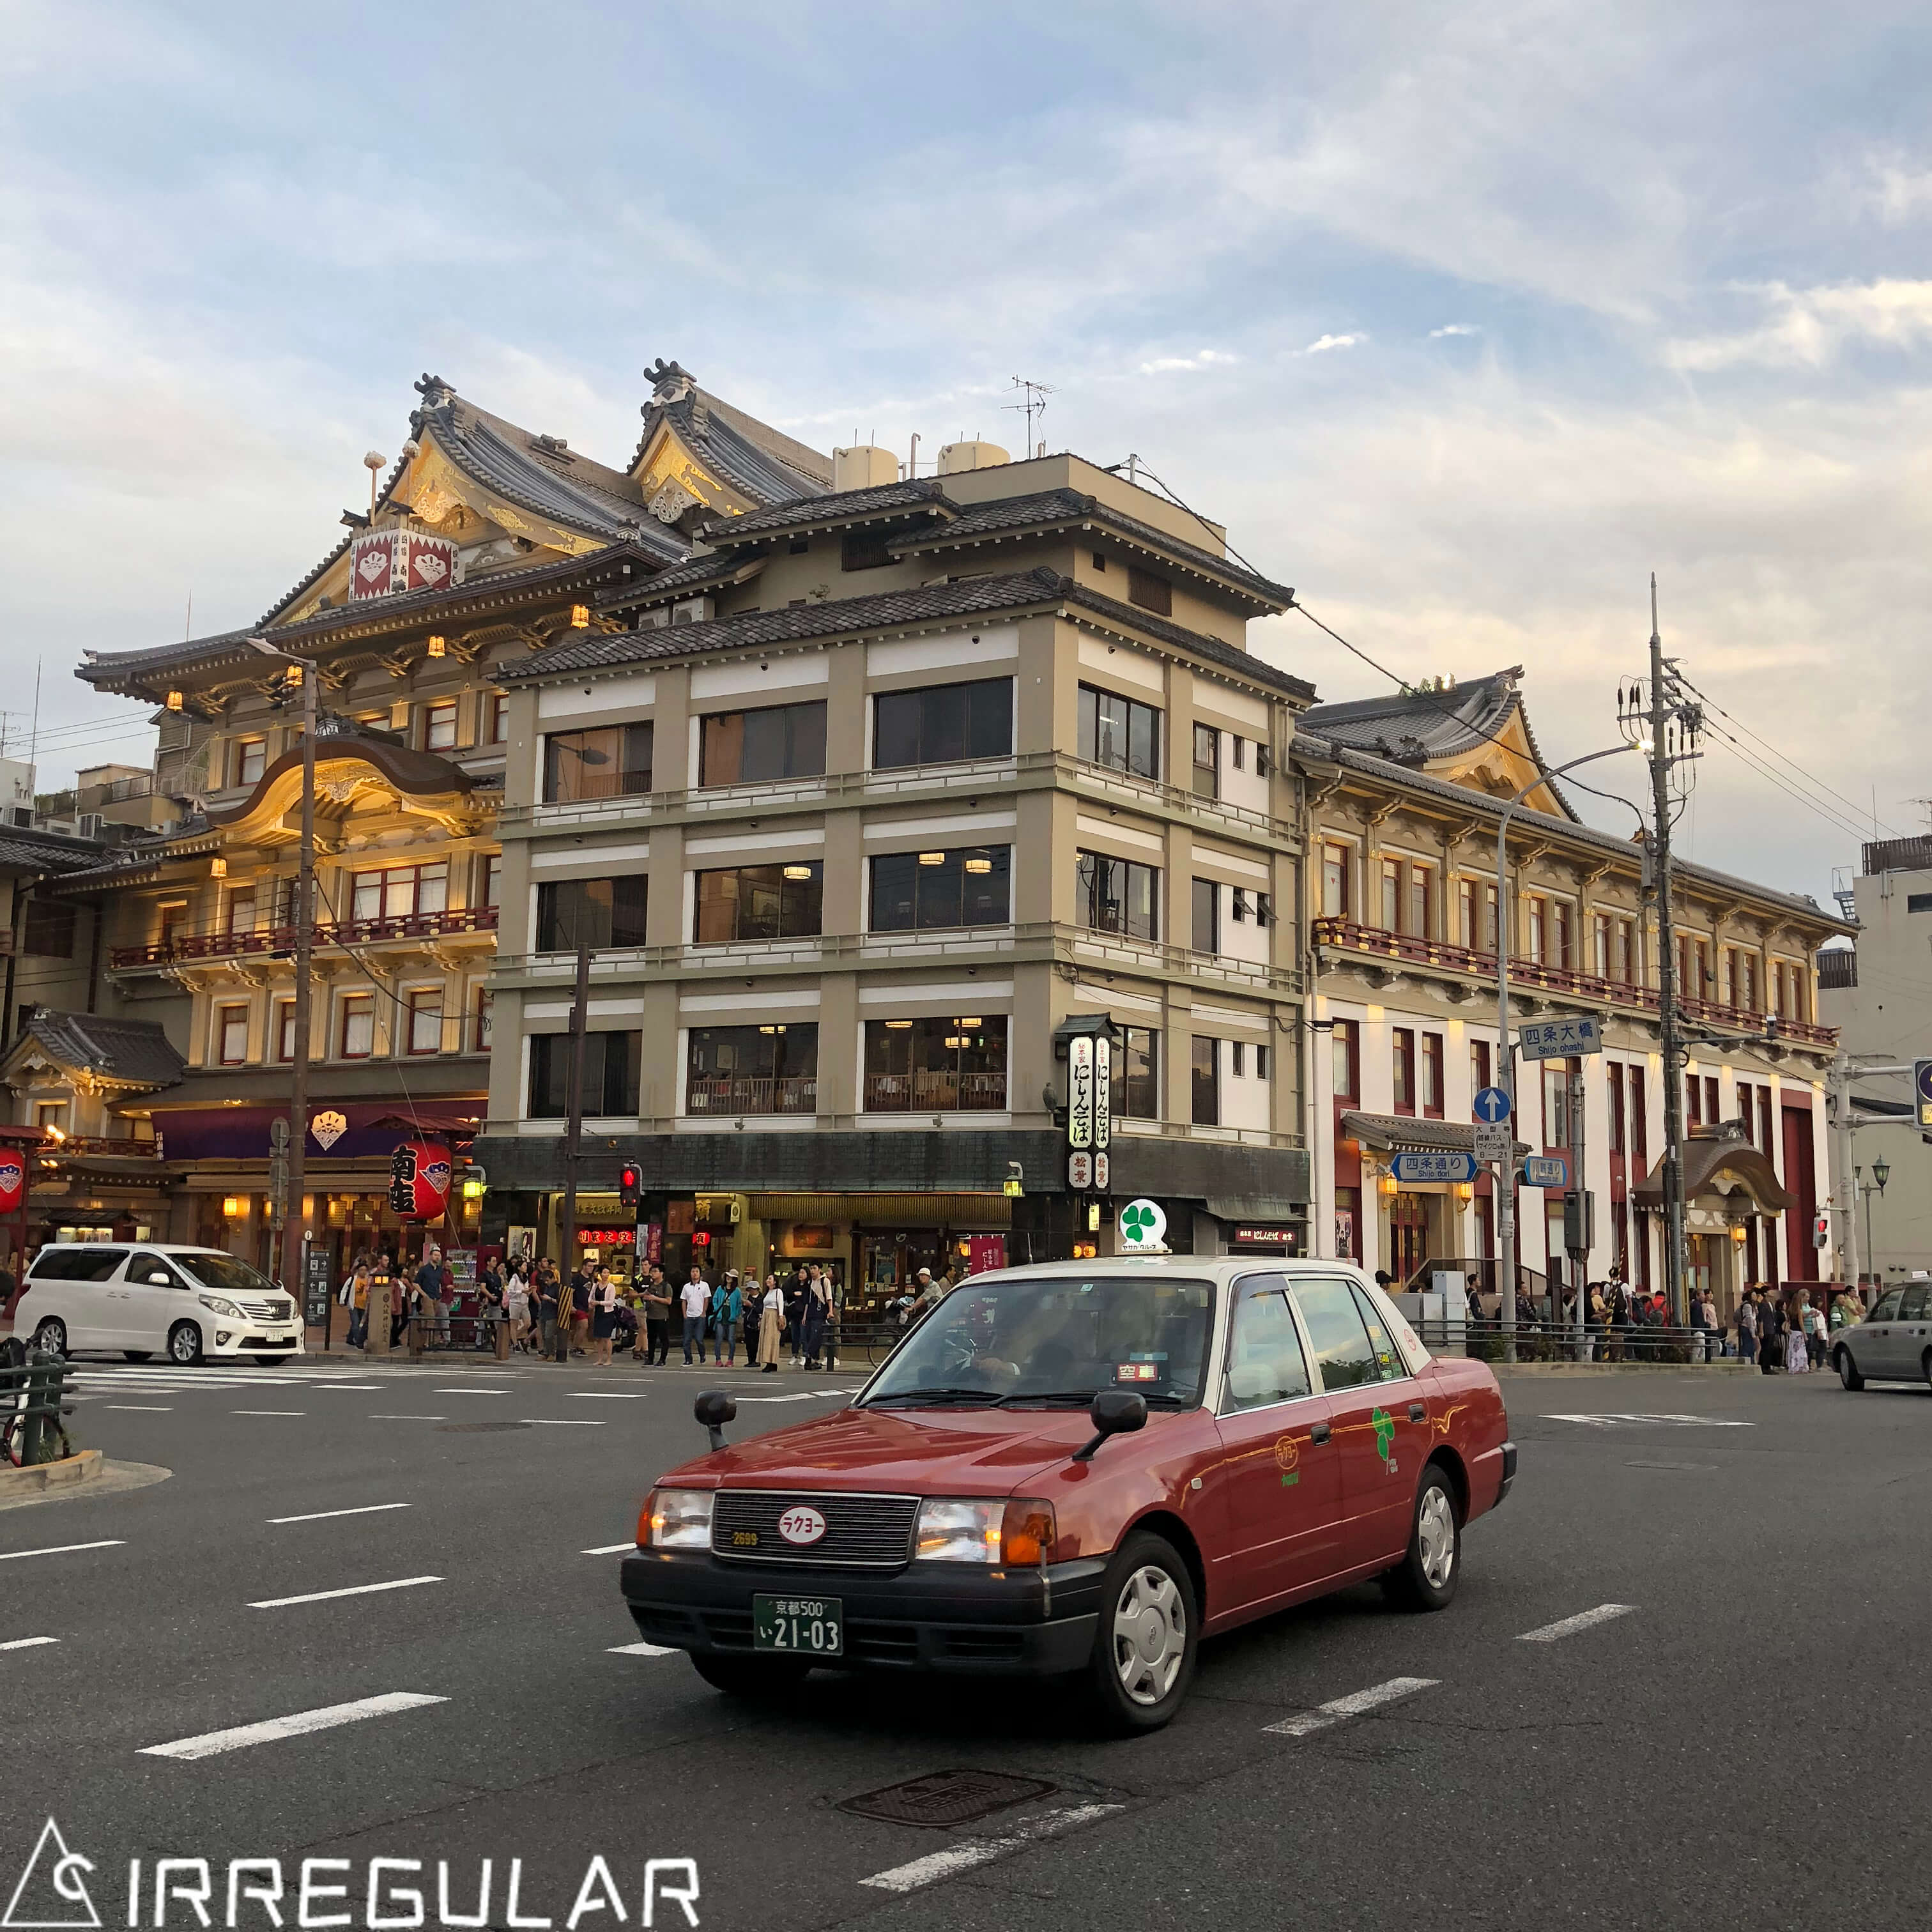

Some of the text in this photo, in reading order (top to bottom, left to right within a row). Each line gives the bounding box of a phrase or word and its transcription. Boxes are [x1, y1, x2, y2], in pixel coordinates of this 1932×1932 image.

[1526, 1022, 1593, 1045] 四条大橋
[1538, 1041, 1584, 1055] Shijo ohashi
[1073, 1064, 1090, 1142] にしんそば
[1096, 1064, 1108, 1142] にしんそば
[1074, 1156, 1087, 1183] 松葉
[1406, 1158, 1461, 1170] 四条通り
[390, 1144, 418, 1214] 南座
[1119, 1364, 1155, 1379] 空車
[781, 1515, 824, 1533] ラクヨー
[733, 1532, 757, 1545] 2699
[776, 1600, 823, 1616] 京都500
[760, 1618, 838, 1650] い 21-03
